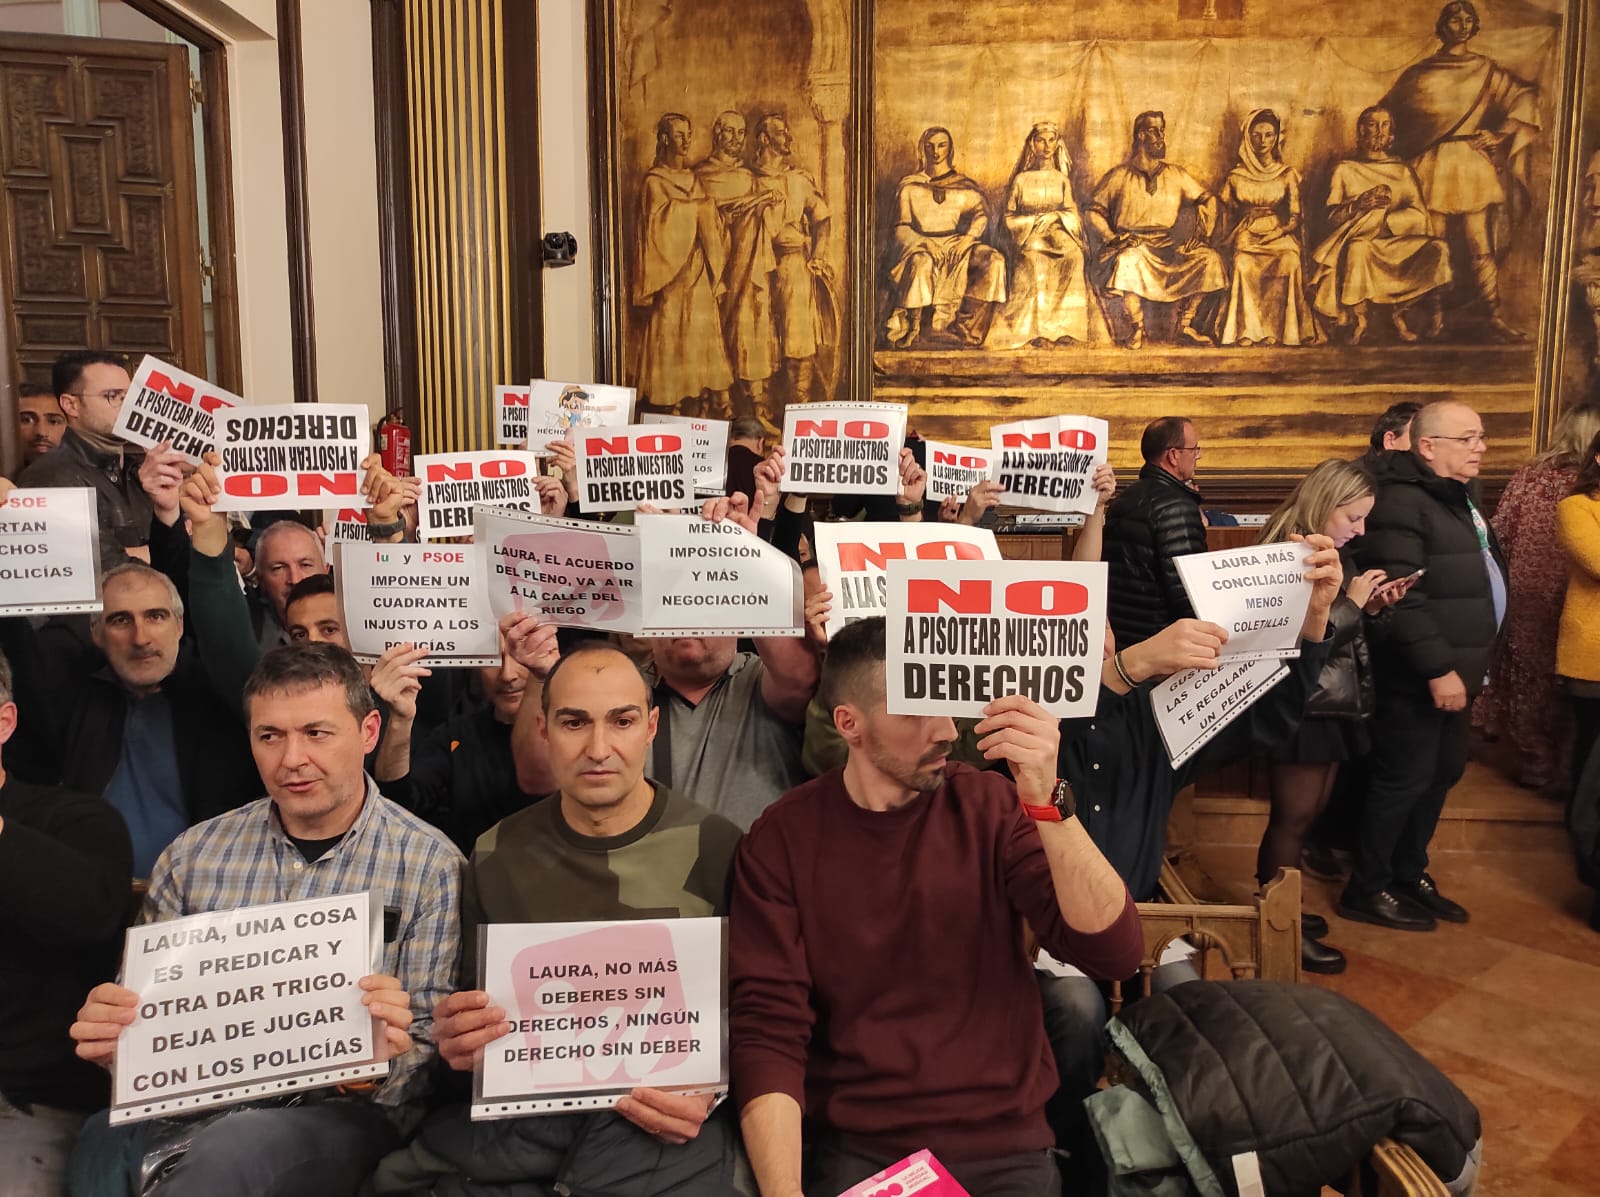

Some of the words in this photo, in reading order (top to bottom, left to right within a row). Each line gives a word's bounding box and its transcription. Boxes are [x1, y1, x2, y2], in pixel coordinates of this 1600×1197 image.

[134, 388, 146, 406] A
[144, 392, 194, 426] PISOTEAR
[504, 393, 529, 406] N
[503, 407, 508, 421] A
[226, 415, 357, 442] DERECHOS
[795, 420, 889, 439] NO
[1002, 429, 1097, 450] NO
[585, 435, 682, 456] NO
[792, 439, 798, 457] A
[799, 439, 841, 459] PISOTEAR
[843, 440, 889, 461] NUESTROS
[223, 446, 286, 472] NUESTROS
[289, 446, 347, 471] PISOTEAR
[350, 446, 358, 470] A
[586, 458, 593, 479] A
[594, 456, 635, 478] PISOTEAR
[637, 454, 684, 476] NUESTROS
[934, 451, 987, 468] NO
[1002, 451, 1010, 469] A
[1012, 452, 1024, 469] LA
[1079, 455, 1093, 475] DE
[427, 460, 526, 482] NO
[790, 463, 888, 485] DERECHOS
[933, 465, 937, 477] A
[938, 465, 944, 479] LA
[224, 473, 357, 497] NO
[427, 485, 434, 504] A
[435, 482, 480, 504] PISOTEAR
[481, 478, 530, 500] NUESTROS
[587, 479, 685, 503] DERECHOS
[1000, 474, 1084, 499] DERECHOS
[9, 497, 48, 508] SOE
[334, 522, 340, 539] A
[689, 523, 742, 536] MENOS
[403, 554, 411, 565] y
[422, 552, 465, 563] PSOE
[493, 545, 540, 564] LAURA,
[545, 554, 560, 565] EL
[565, 558, 634, 571] ACUERDO
[670, 545, 761, 558] IMPOSICIÓN
[1212, 555, 1261, 570] LAURA
[371, 575, 442, 586] IMPONEN
[448, 576, 470, 586] UN
[496, 565, 520, 577] DEL
[524, 569, 571, 586] PLENO,
[576, 577, 595, 586] VA
[619, 579, 633, 587] IR
[692, 571, 701, 582] Y
[707, 568, 739, 582] MÁS
[1212, 570, 1302, 591] CONCILIACIÓN
[373, 598, 468, 608] CUADRANTE
[510, 586, 519, 595] A
[523, 588, 537, 599] LA
[542, 592, 587, 601] CALLE
[592, 593, 619, 602] DEL
[662, 592, 769, 606] NEGOCIACIÓN
[841, 577, 855, 609] A
[854, 577, 877, 608] LA
[908, 579, 1089, 616] NO
[1246, 596, 1283, 609] MENOS
[542, 606, 586, 615] RIEGO
[364, 619, 428, 630] INJUSTO
[433, 620, 443, 630] A
[449, 619, 479, 630] LOS
[1233, 616, 1289, 633] COLETILLAS
[904, 616, 915, 654] A
[919, 616, 1000, 656] PISOTEAR
[1005, 617, 1089, 657] NUESTROS
[903, 662, 1085, 703] DERECHOS
[1178, 709, 1195, 726] TE
[1196, 660, 1256, 711] REGALAMO
[1166, 690, 1189, 713] LAS
[1199, 712, 1216, 730] UN
[1221, 680, 1254, 711] PEINE
[143, 926, 227, 954] LAURA,
[235, 916, 286, 938] UNA
[293, 906, 357, 929] COSA
[153, 964, 183, 984] ES
[199, 943, 319, 976] PREDICAR
[328, 940, 343, 955] Y
[529, 965, 599, 979] LAURA,
[605, 962, 632, 975] NO
[638, 958, 678, 974] MÁS
[140, 995, 208, 1020] OTRA
[216, 985, 265, 1007] DAR
[272, 972, 353, 998] TRIGO.
[542, 989, 628, 1005] DEBERES
[634, 986, 666, 999] SIN
[152, 1028, 217, 1053] DEJA
[225, 1021, 255, 1041] DE
[264, 1006, 345, 1033] JUGAR
[508, 1015, 609, 1033] DERECHOS
[626, 1008, 700, 1027] NINGÚN
[504, 1044, 595, 1063] DERECHO
[601, 1042, 633, 1057] SIN
[639, 1039, 701, 1055] DEBER
[133, 1067, 188, 1092] CON
[197, 1057, 244, 1081] LOS
[253, 1037, 363, 1070] POLICÍAS
